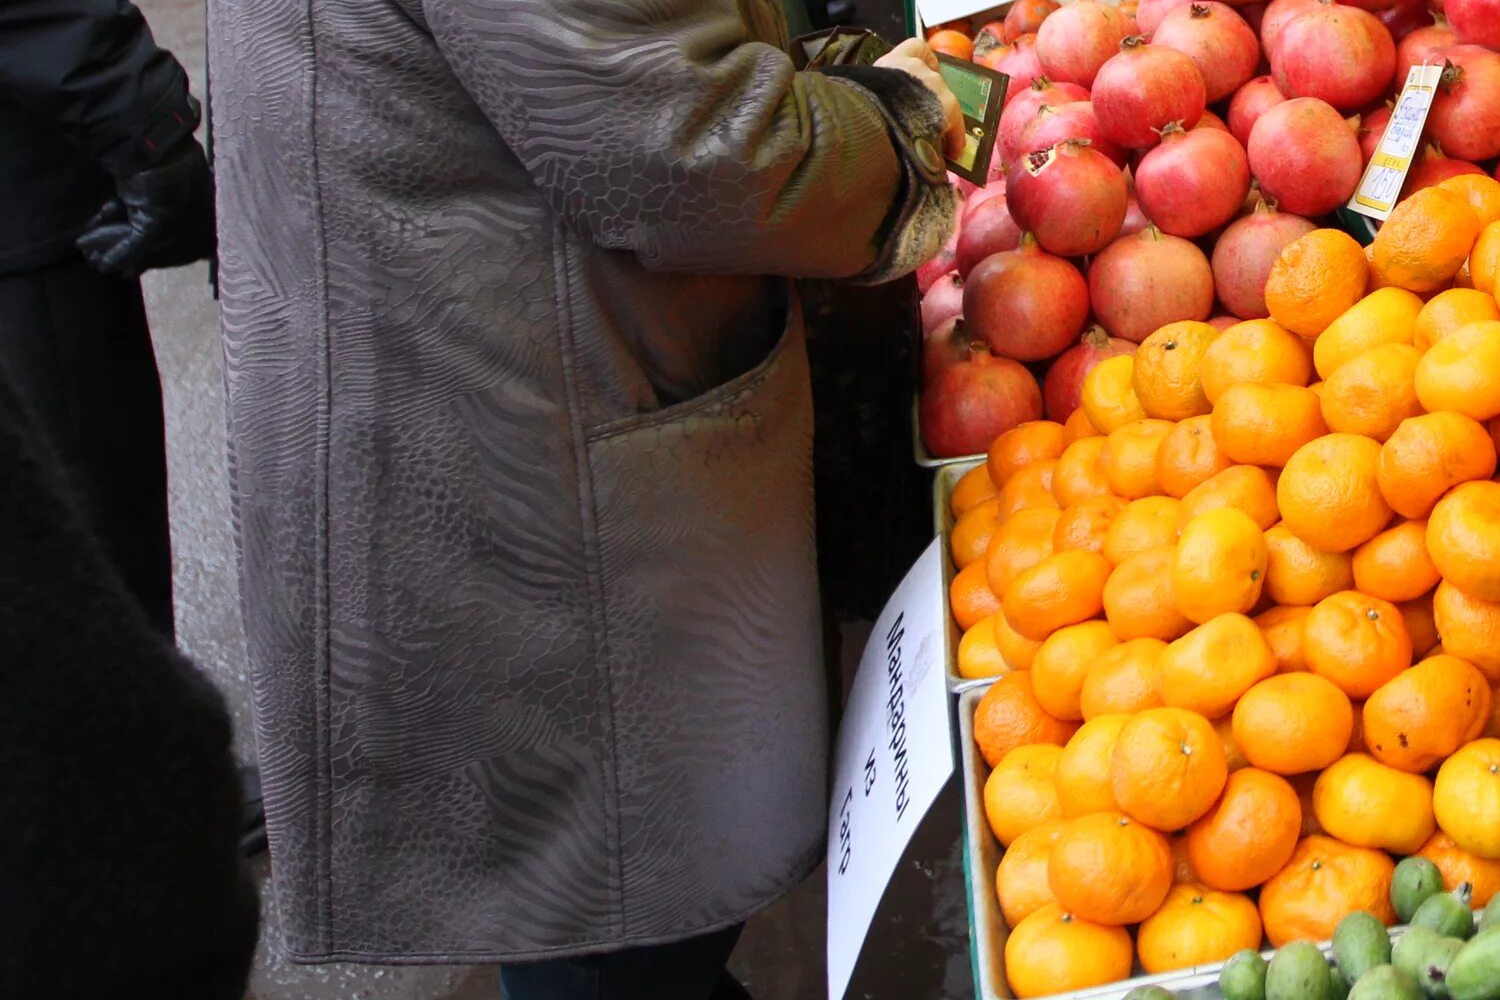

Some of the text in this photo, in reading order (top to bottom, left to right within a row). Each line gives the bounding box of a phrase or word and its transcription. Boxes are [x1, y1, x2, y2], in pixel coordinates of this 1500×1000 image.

[886, 610, 910, 824] Мандарины
[864, 746, 877, 798] из
[838, 785, 853, 876] Гагр
